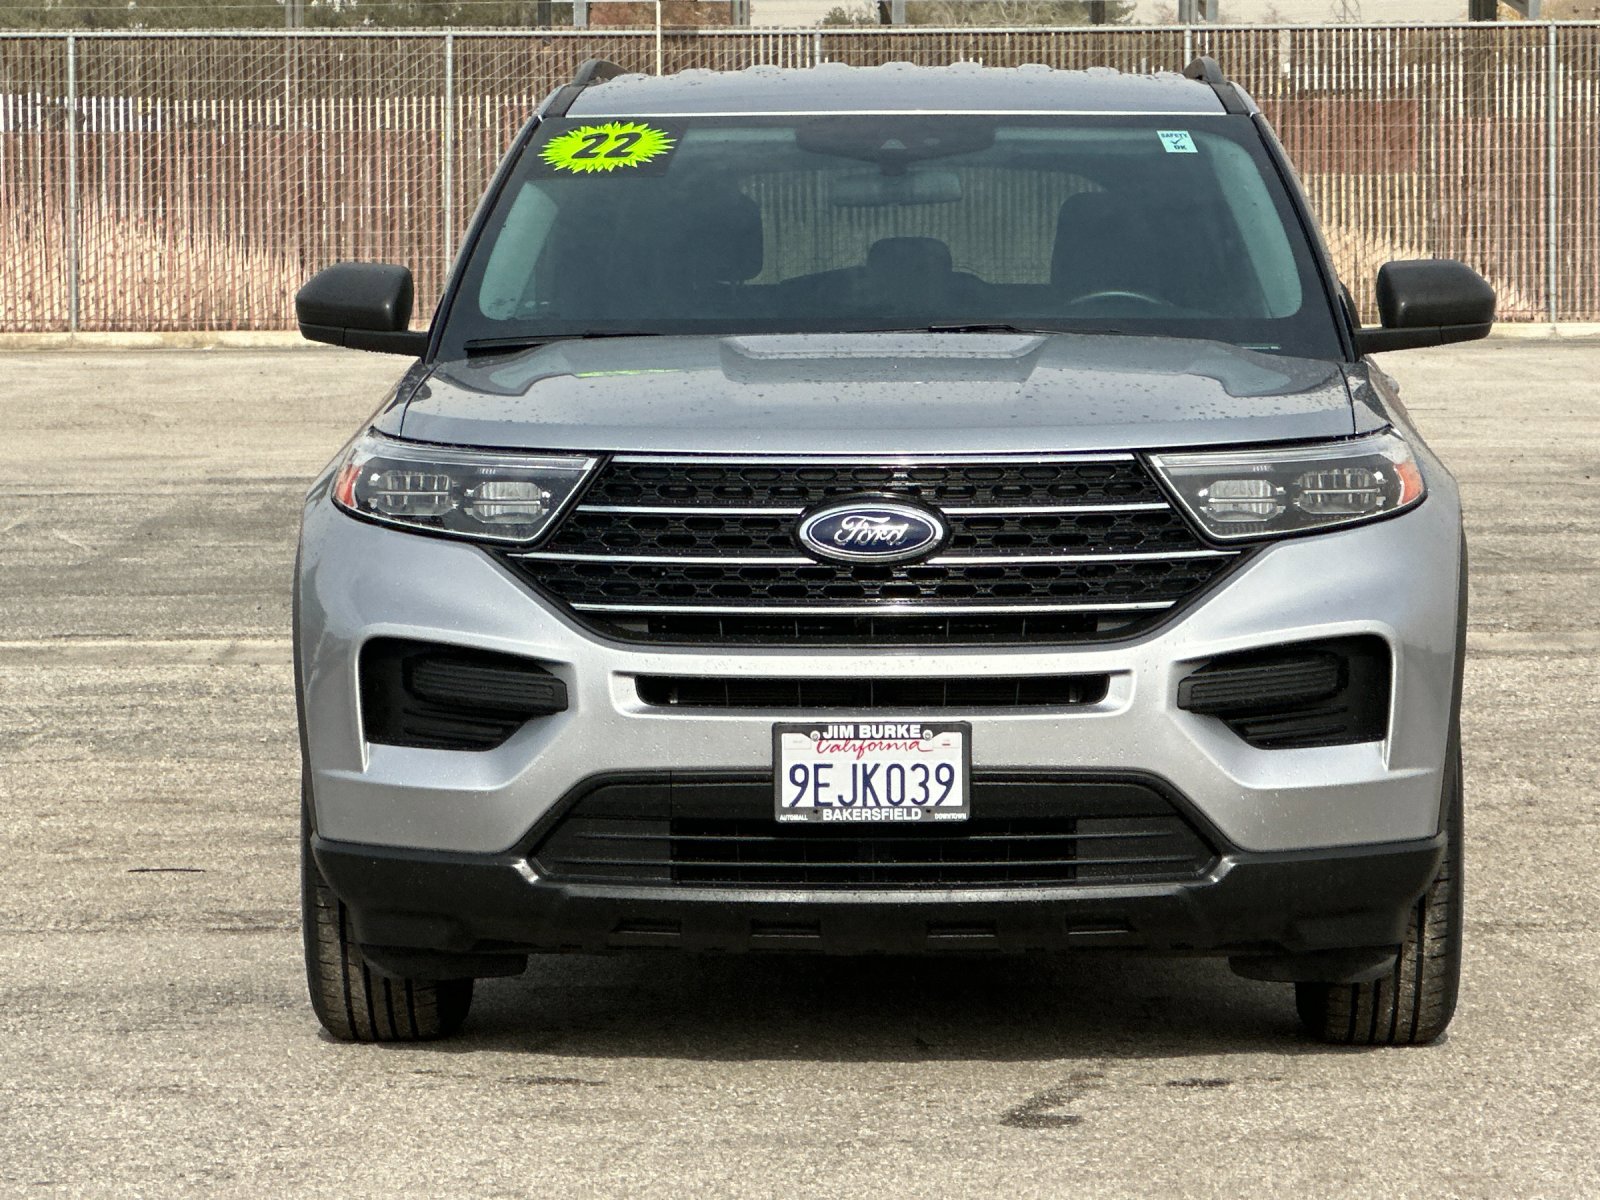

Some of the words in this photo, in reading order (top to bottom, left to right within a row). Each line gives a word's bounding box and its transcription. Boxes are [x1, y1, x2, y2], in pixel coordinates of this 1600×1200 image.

[571, 132, 643, 159] 22
[833, 515, 909, 546] Ford
[822, 724, 854, 739] JIM
[858, 724, 921, 739] BURKE
[816, 739, 934, 760] California
[789, 762, 955, 807] 9EJK039
[822, 807, 922, 821] BAKERSFIELD
